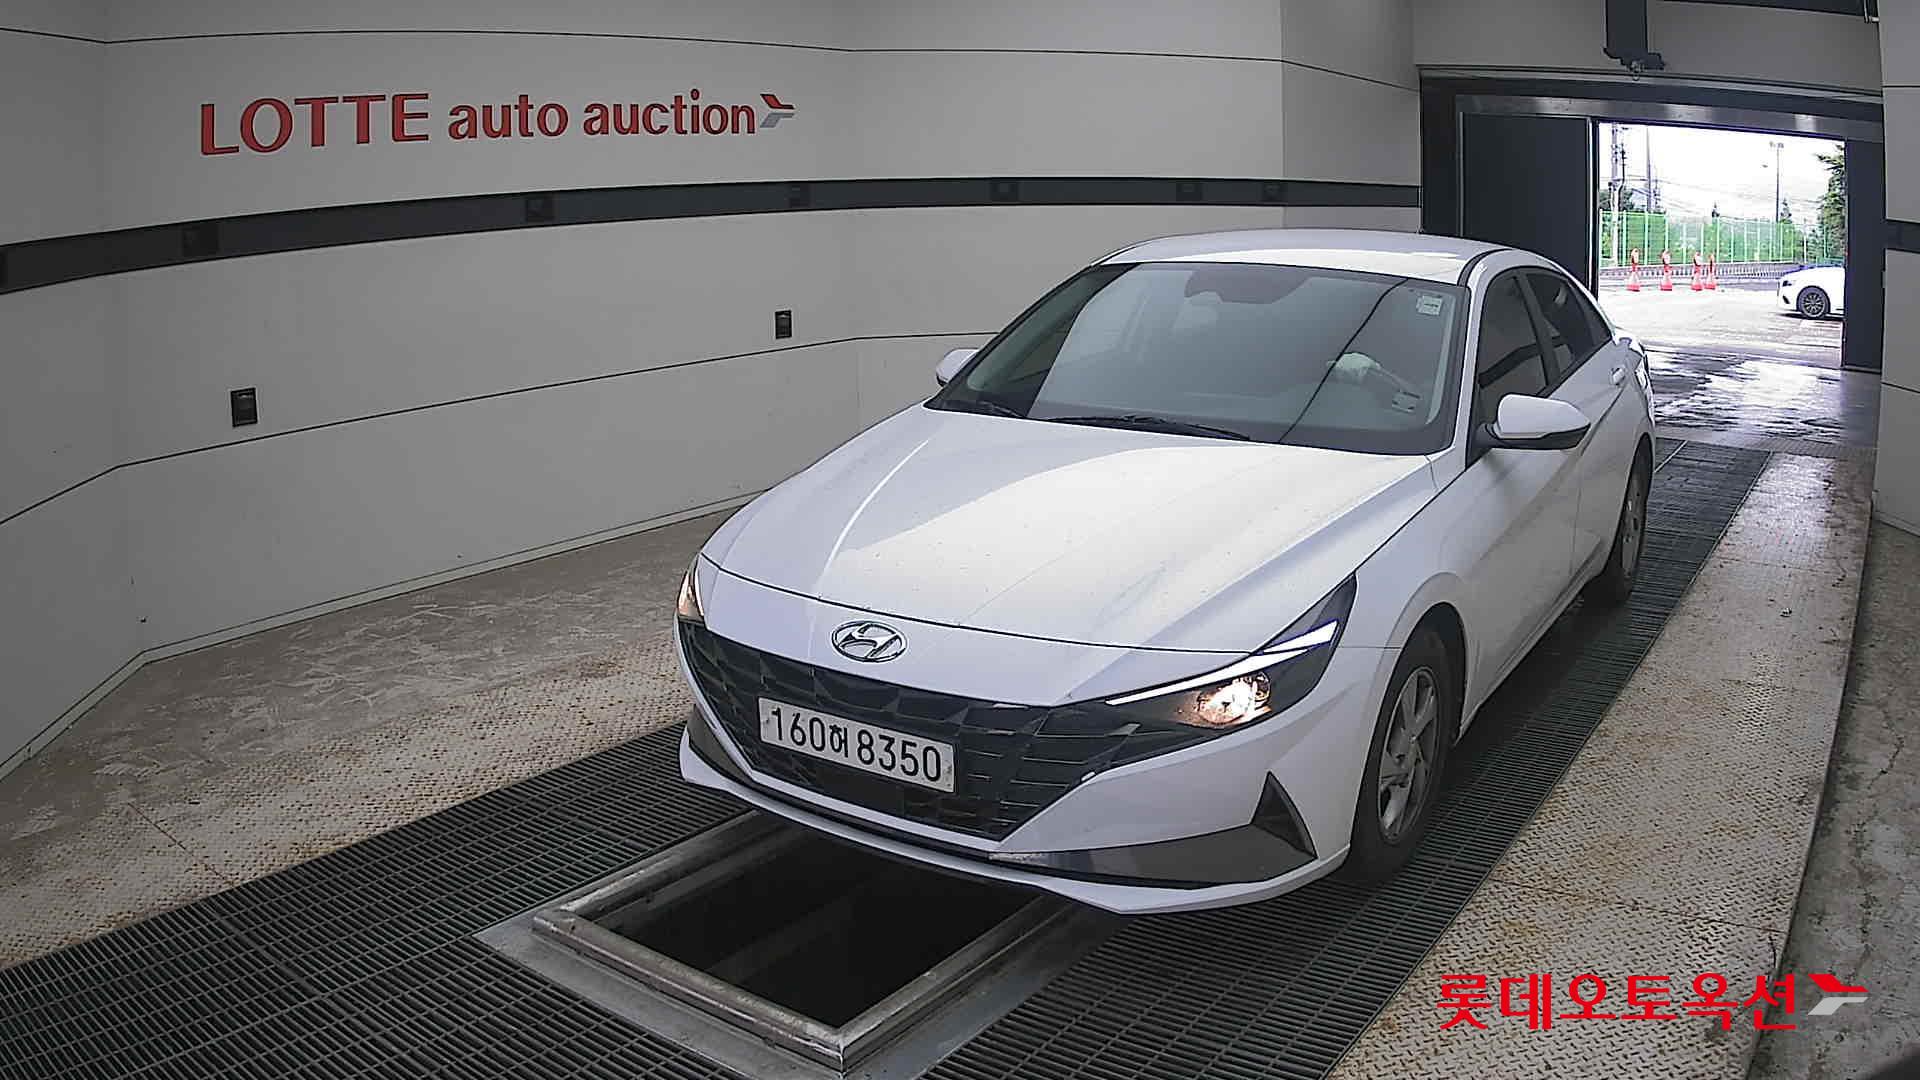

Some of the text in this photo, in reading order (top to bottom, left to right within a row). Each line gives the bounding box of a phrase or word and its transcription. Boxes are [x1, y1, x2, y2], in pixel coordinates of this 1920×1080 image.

[200, 88, 756, 156] LOTTE auto auction
[856, 729, 942, 782] 8350
